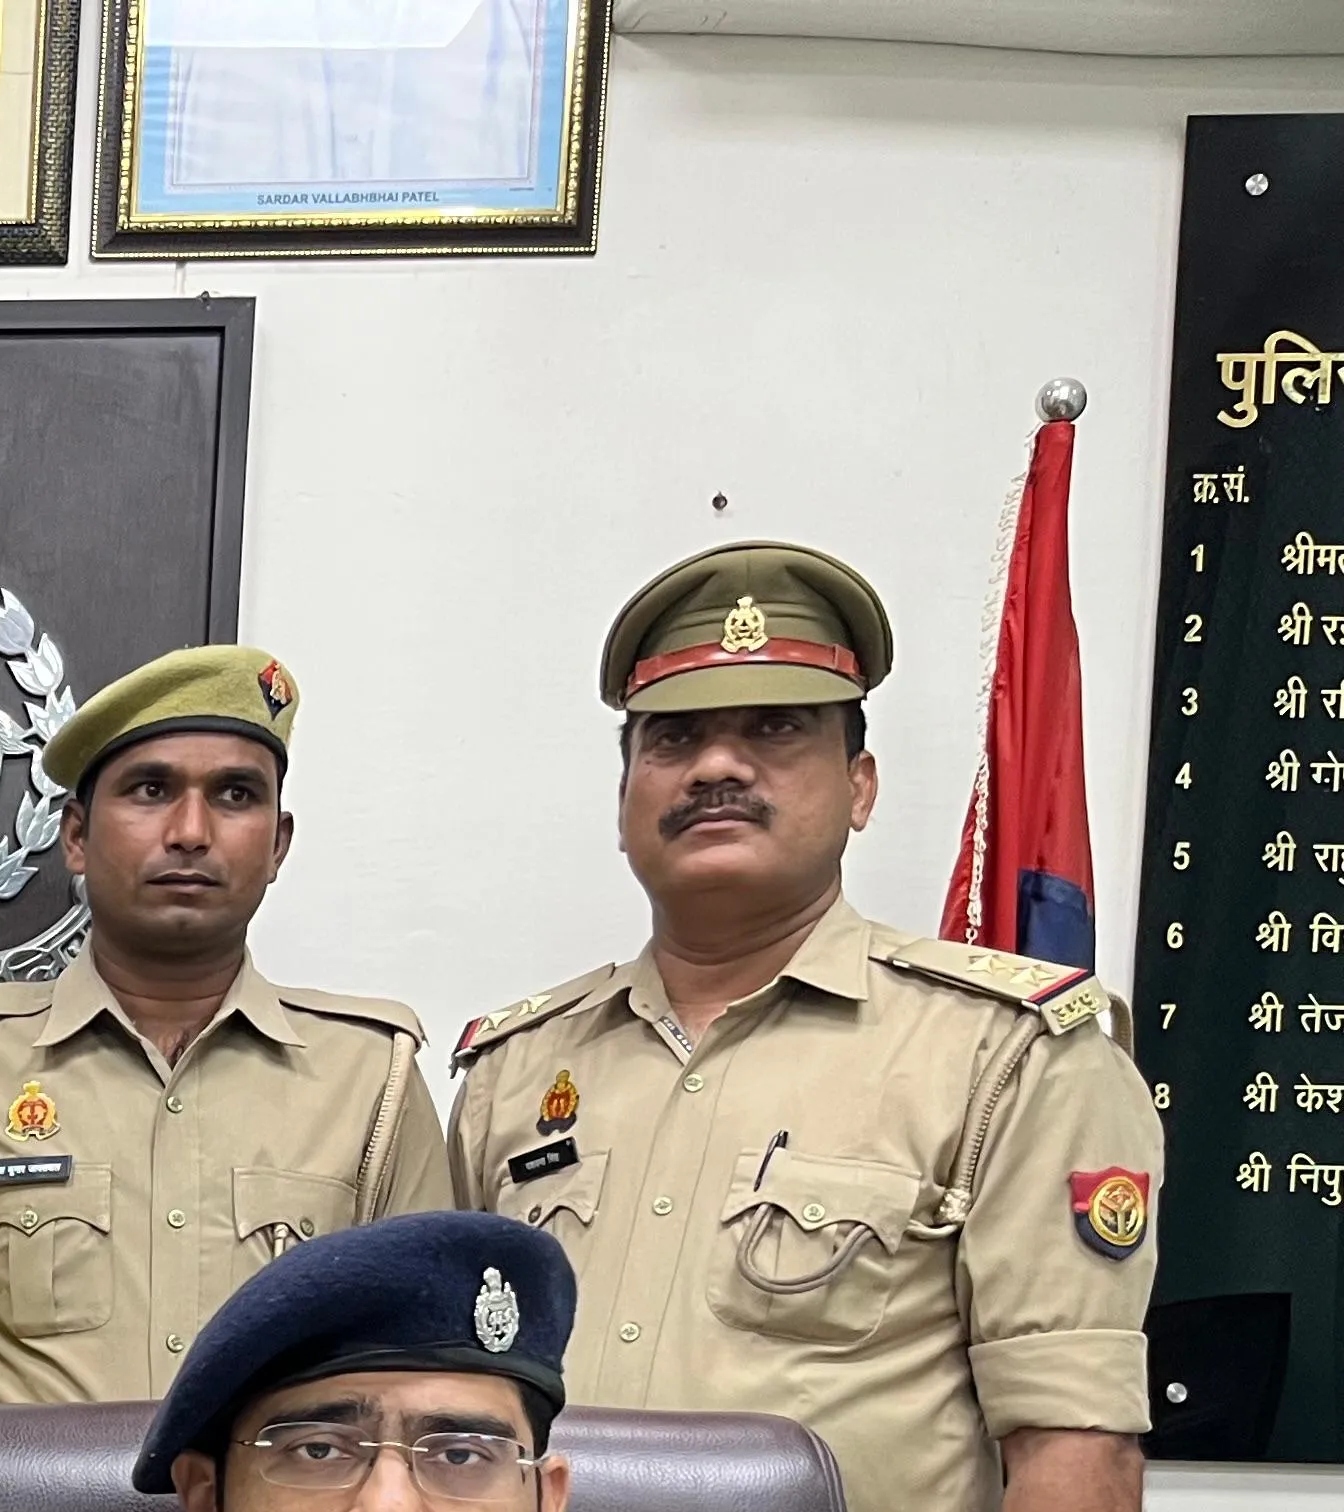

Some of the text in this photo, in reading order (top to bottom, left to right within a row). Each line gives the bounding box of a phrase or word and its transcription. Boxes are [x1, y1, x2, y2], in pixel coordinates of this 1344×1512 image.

[257, 190, 440, 206] SARDAR VALLABHBHAI PATEL
[1216, 330, 1344, 429] पुलि
[1190, 543, 1205, 573] 1
[1183, 614, 1203, 643] 2
[1277, 602, 1312, 646] श्री
[1181, 687, 1199, 716] 3
[1273, 676, 1307, 719] श्री
[1175, 761, 1192, 790] 4
[1265, 748, 1301, 792] श्री
[1172, 841, 1190, 871] 5
[1261, 830, 1296, 872] श्री
[1166, 922, 1184, 949] 6
[1255, 910, 1291, 953] श्री
[1159, 1003, 1177, 1030] 7
[1247, 991, 1284, 1033] श्री
[1154, 1083, 1171, 1110] 8
[1242, 1071, 1278, 1113] श्री
[1235, 1151, 1272, 1193] श्री
